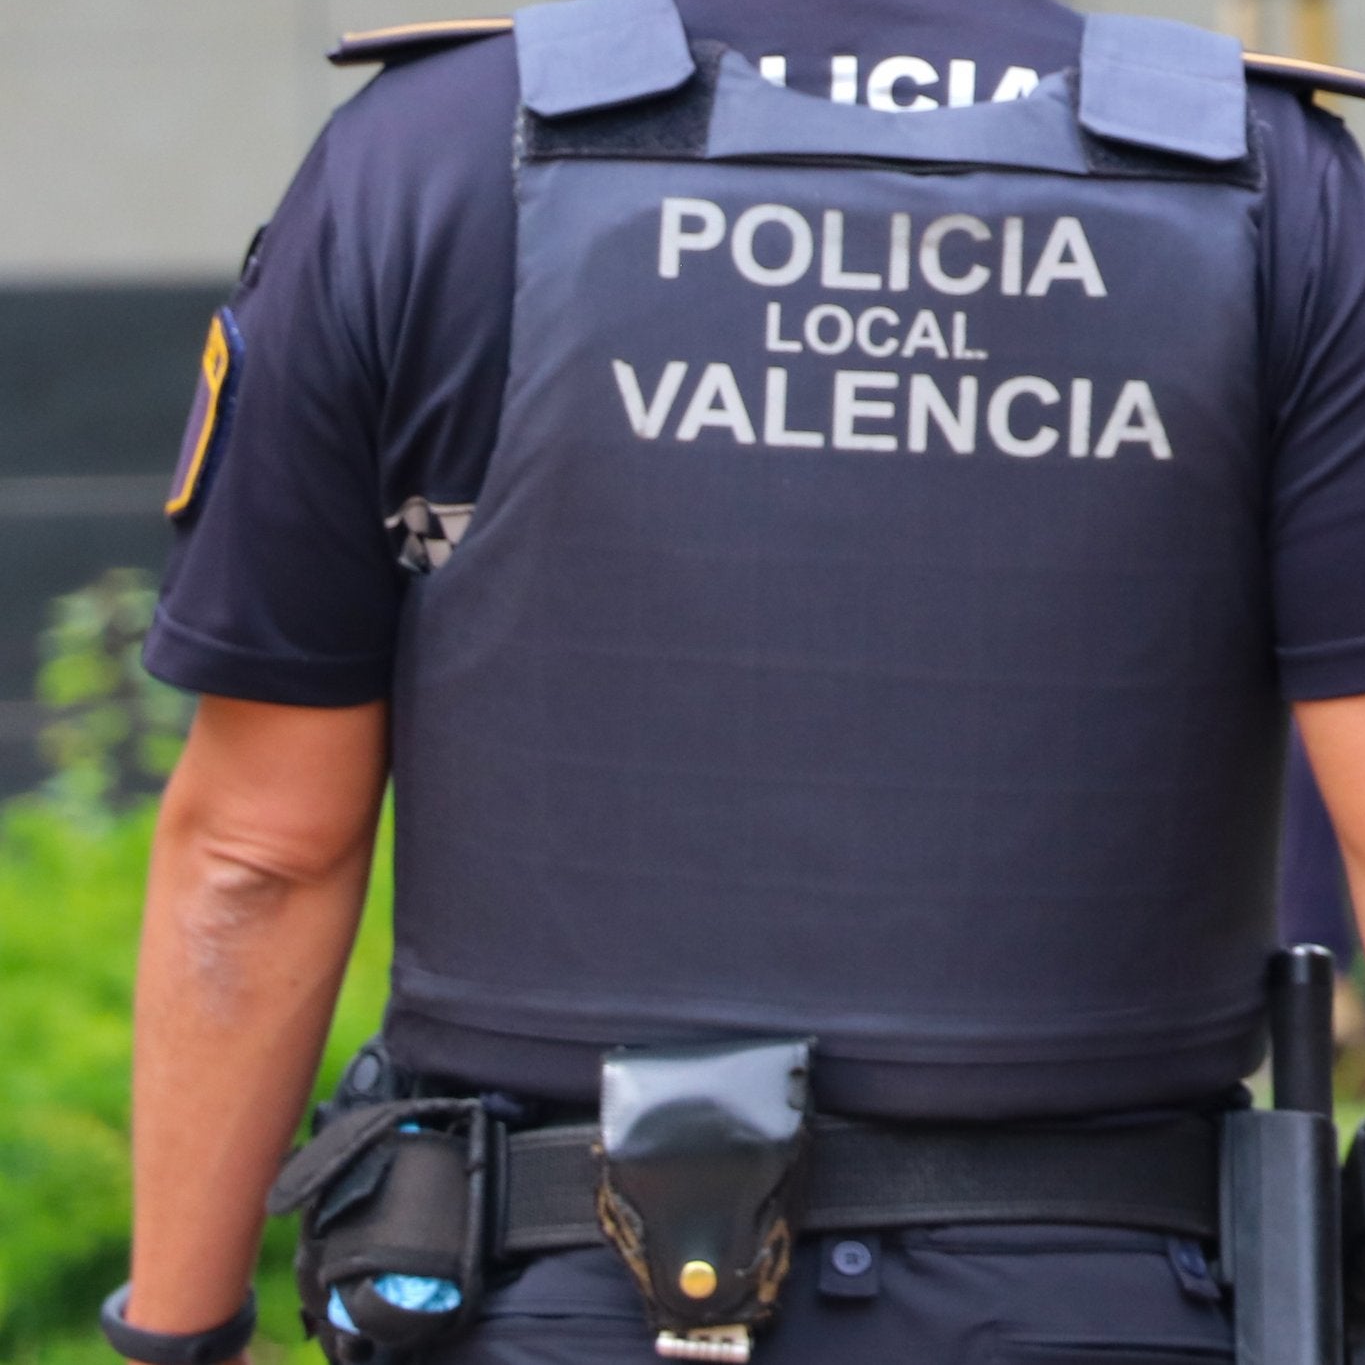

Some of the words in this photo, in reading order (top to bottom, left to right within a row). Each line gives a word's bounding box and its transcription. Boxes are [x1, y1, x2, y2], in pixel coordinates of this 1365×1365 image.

[656, 197, 1108, 298] POLICIA
[764, 301, 990, 361] LOCAL
[611, 358, 1174, 461] VALENCIA
